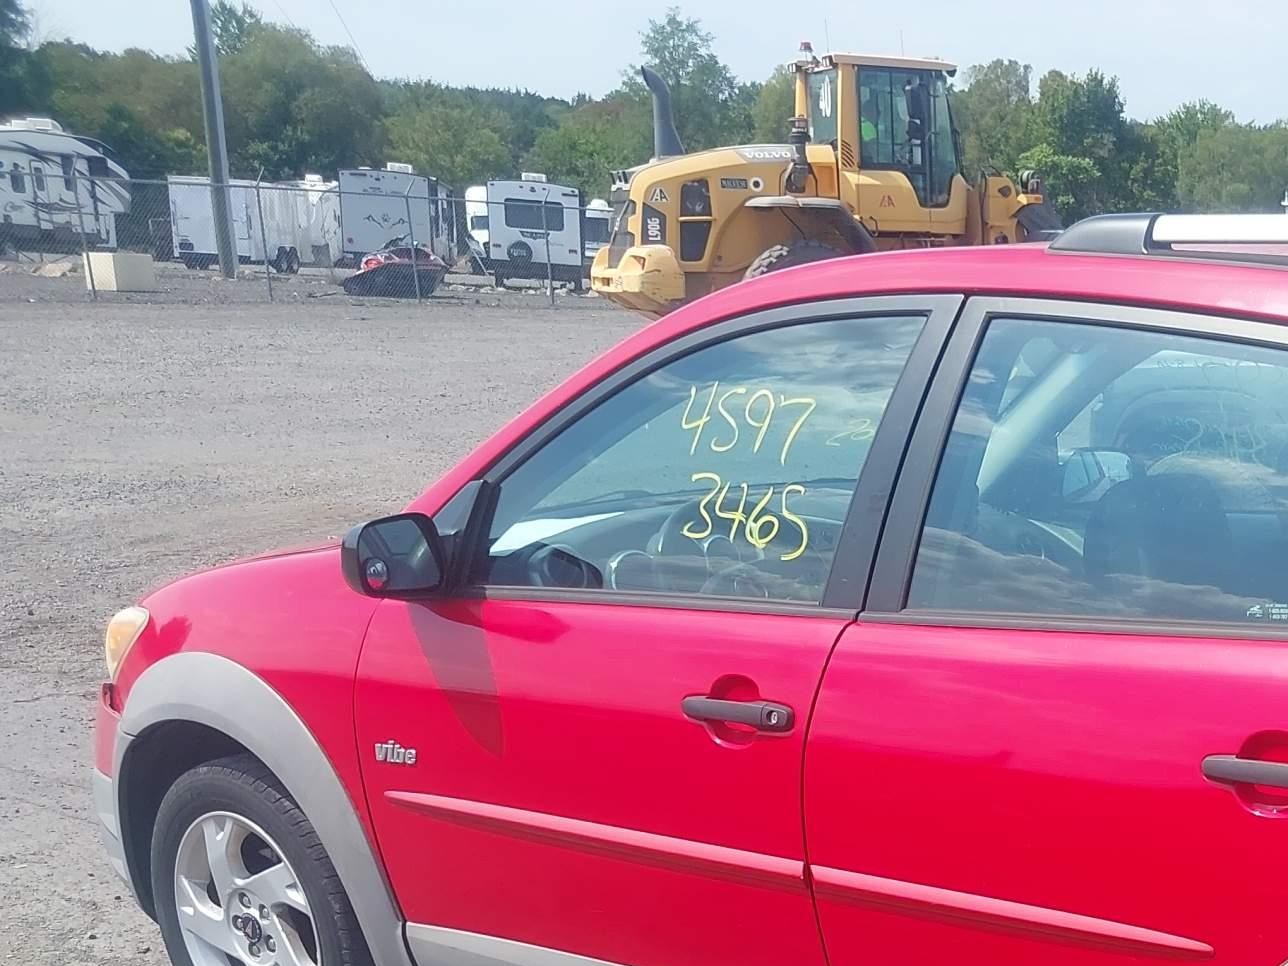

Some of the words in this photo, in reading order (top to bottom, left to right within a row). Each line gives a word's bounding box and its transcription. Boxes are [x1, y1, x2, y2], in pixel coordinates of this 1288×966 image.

[745, 150, 792, 159] VOLVO
[647, 217, 661, 241] L90G
[680, 380, 817, 466] 4597
[679, 472, 809, 562] 3465
